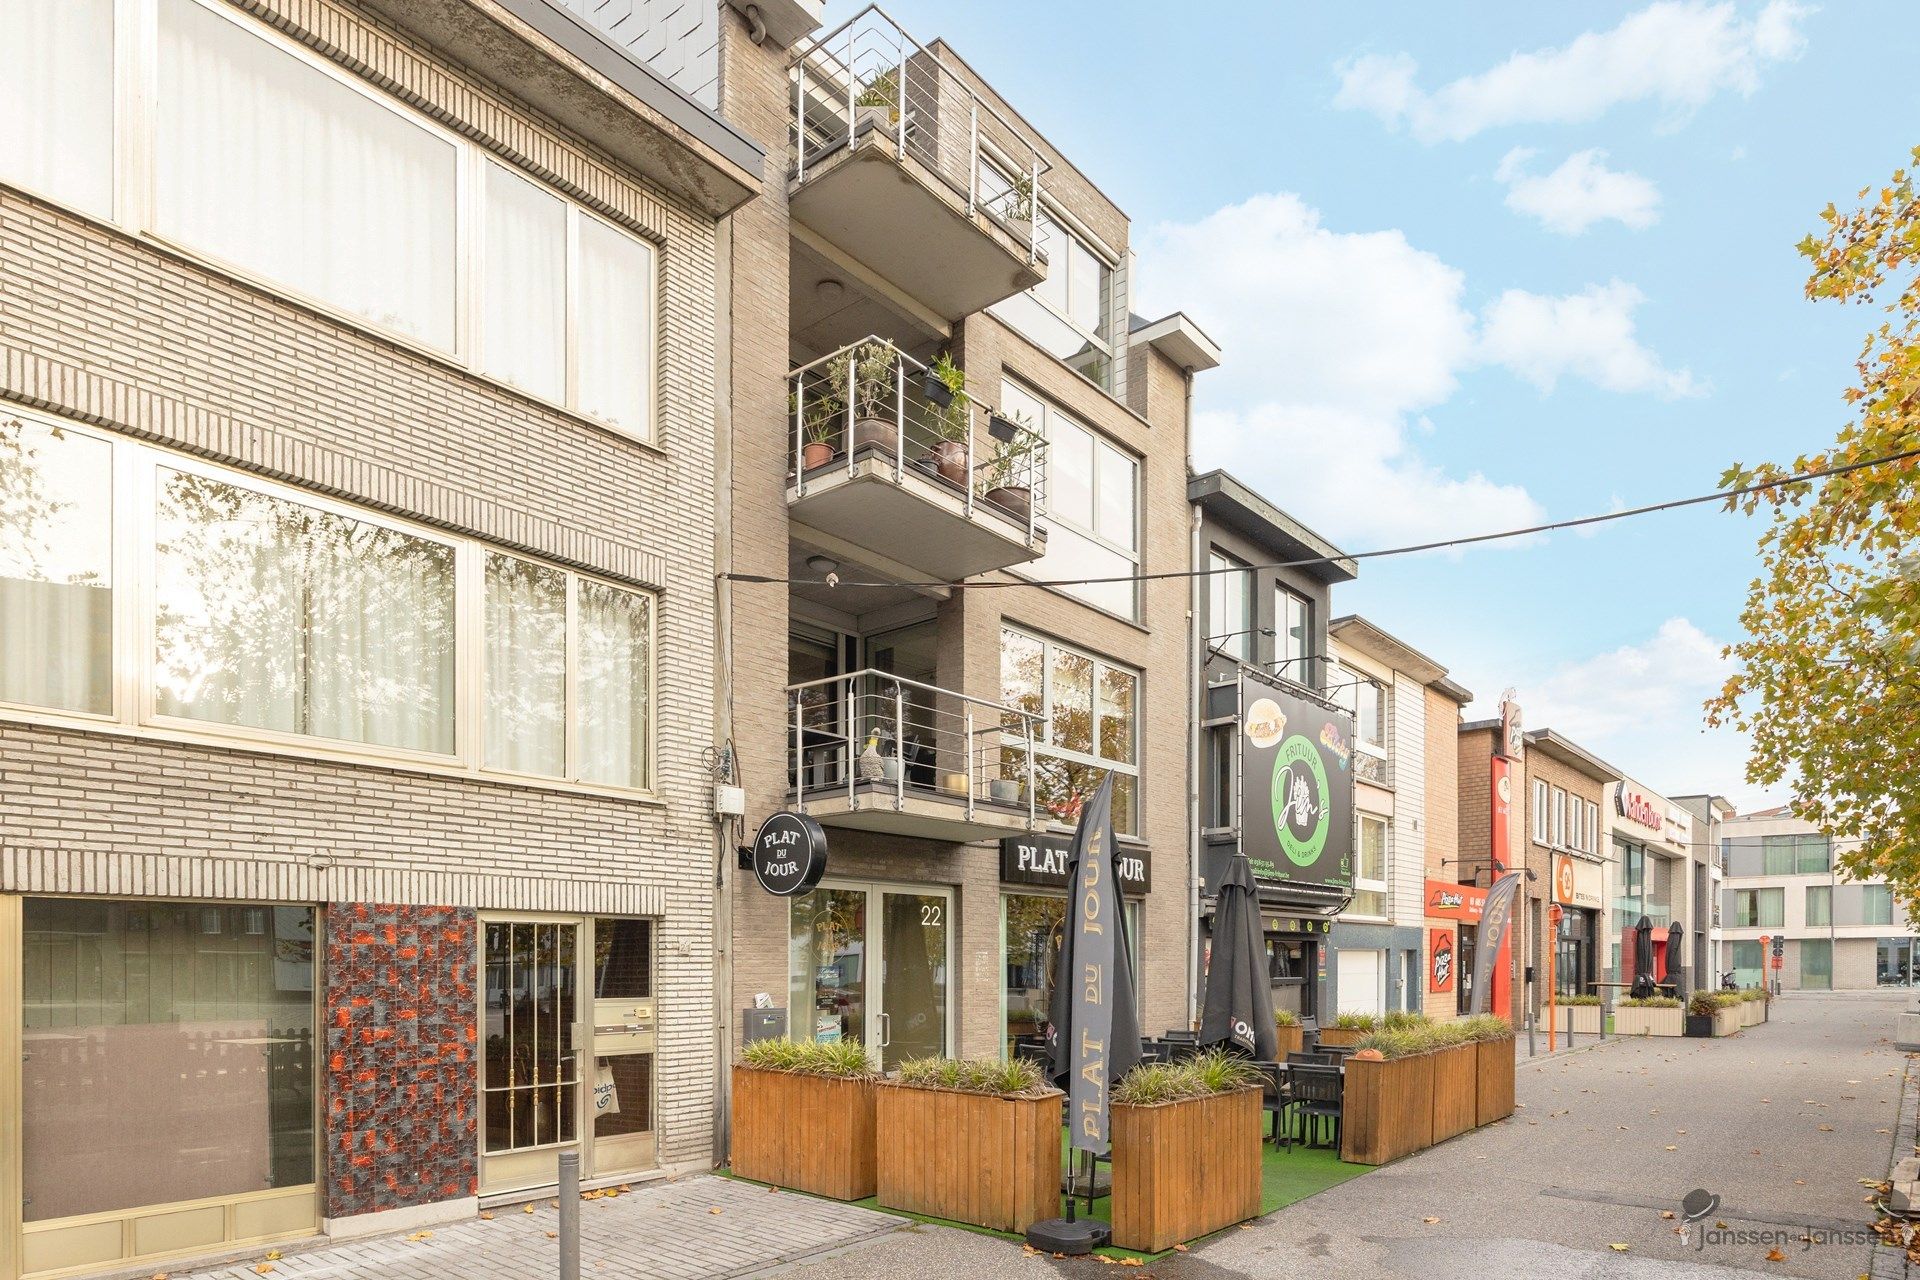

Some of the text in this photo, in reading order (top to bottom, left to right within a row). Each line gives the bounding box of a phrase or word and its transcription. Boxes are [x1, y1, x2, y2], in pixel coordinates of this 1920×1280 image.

[1285, 743, 1317, 768] FRITUUR
[763, 830, 801, 848] PLAT
[776, 849, 787, 859] DU
[1017, 845, 1068, 875] PLAT
[764, 861, 800, 876] JOUR
[921, 905, 941, 926] 22
[1081, 827, 1103, 1141] PLAT DU JOUR
